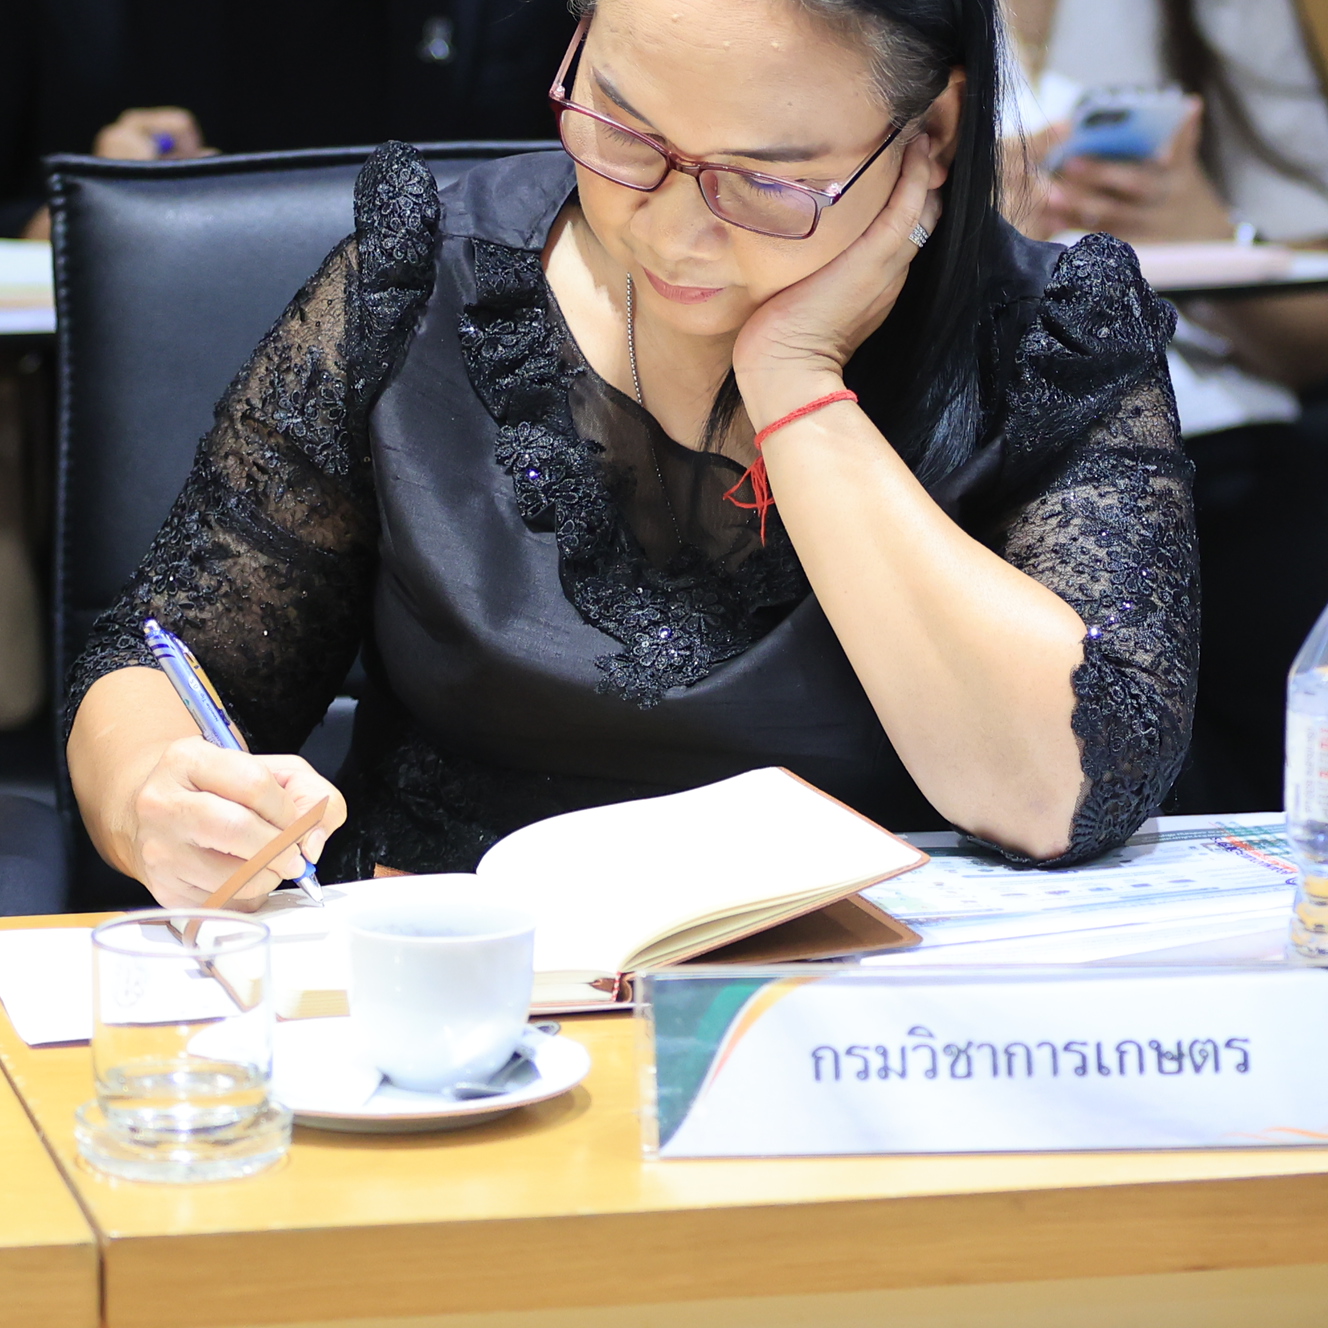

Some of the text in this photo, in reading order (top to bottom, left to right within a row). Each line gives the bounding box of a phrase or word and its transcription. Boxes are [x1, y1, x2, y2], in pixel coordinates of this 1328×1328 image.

[810, 1025, 1252, 1083] กรมวิชาการเกษตร
